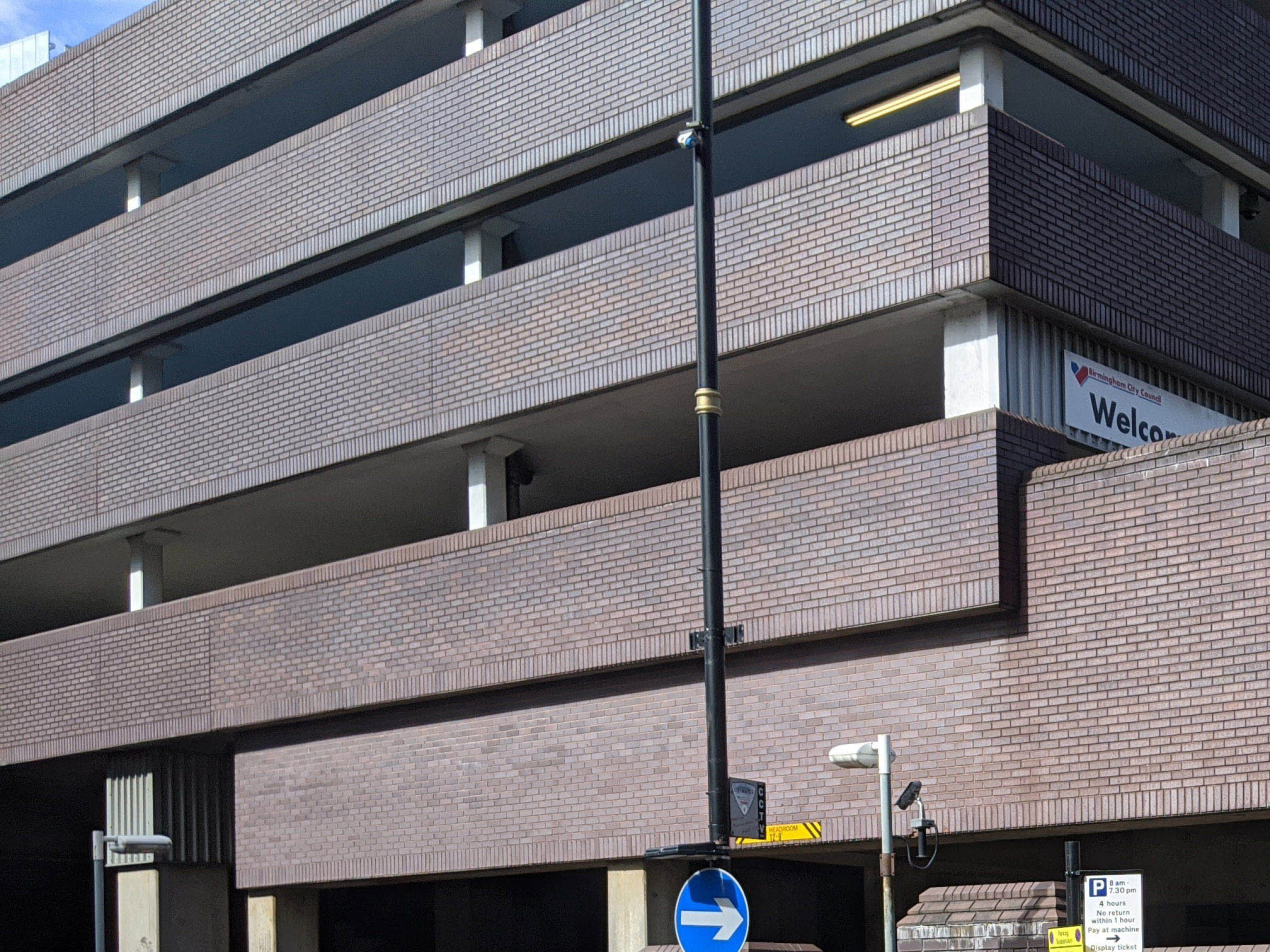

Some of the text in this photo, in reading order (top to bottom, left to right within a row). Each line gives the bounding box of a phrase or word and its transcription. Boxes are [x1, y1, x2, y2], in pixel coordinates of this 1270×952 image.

[1089, 367, 1162, 403] Birmingham City Council
[768, 825, 798, 833] HEADROOM
[1093, 879, 1105, 896] P
